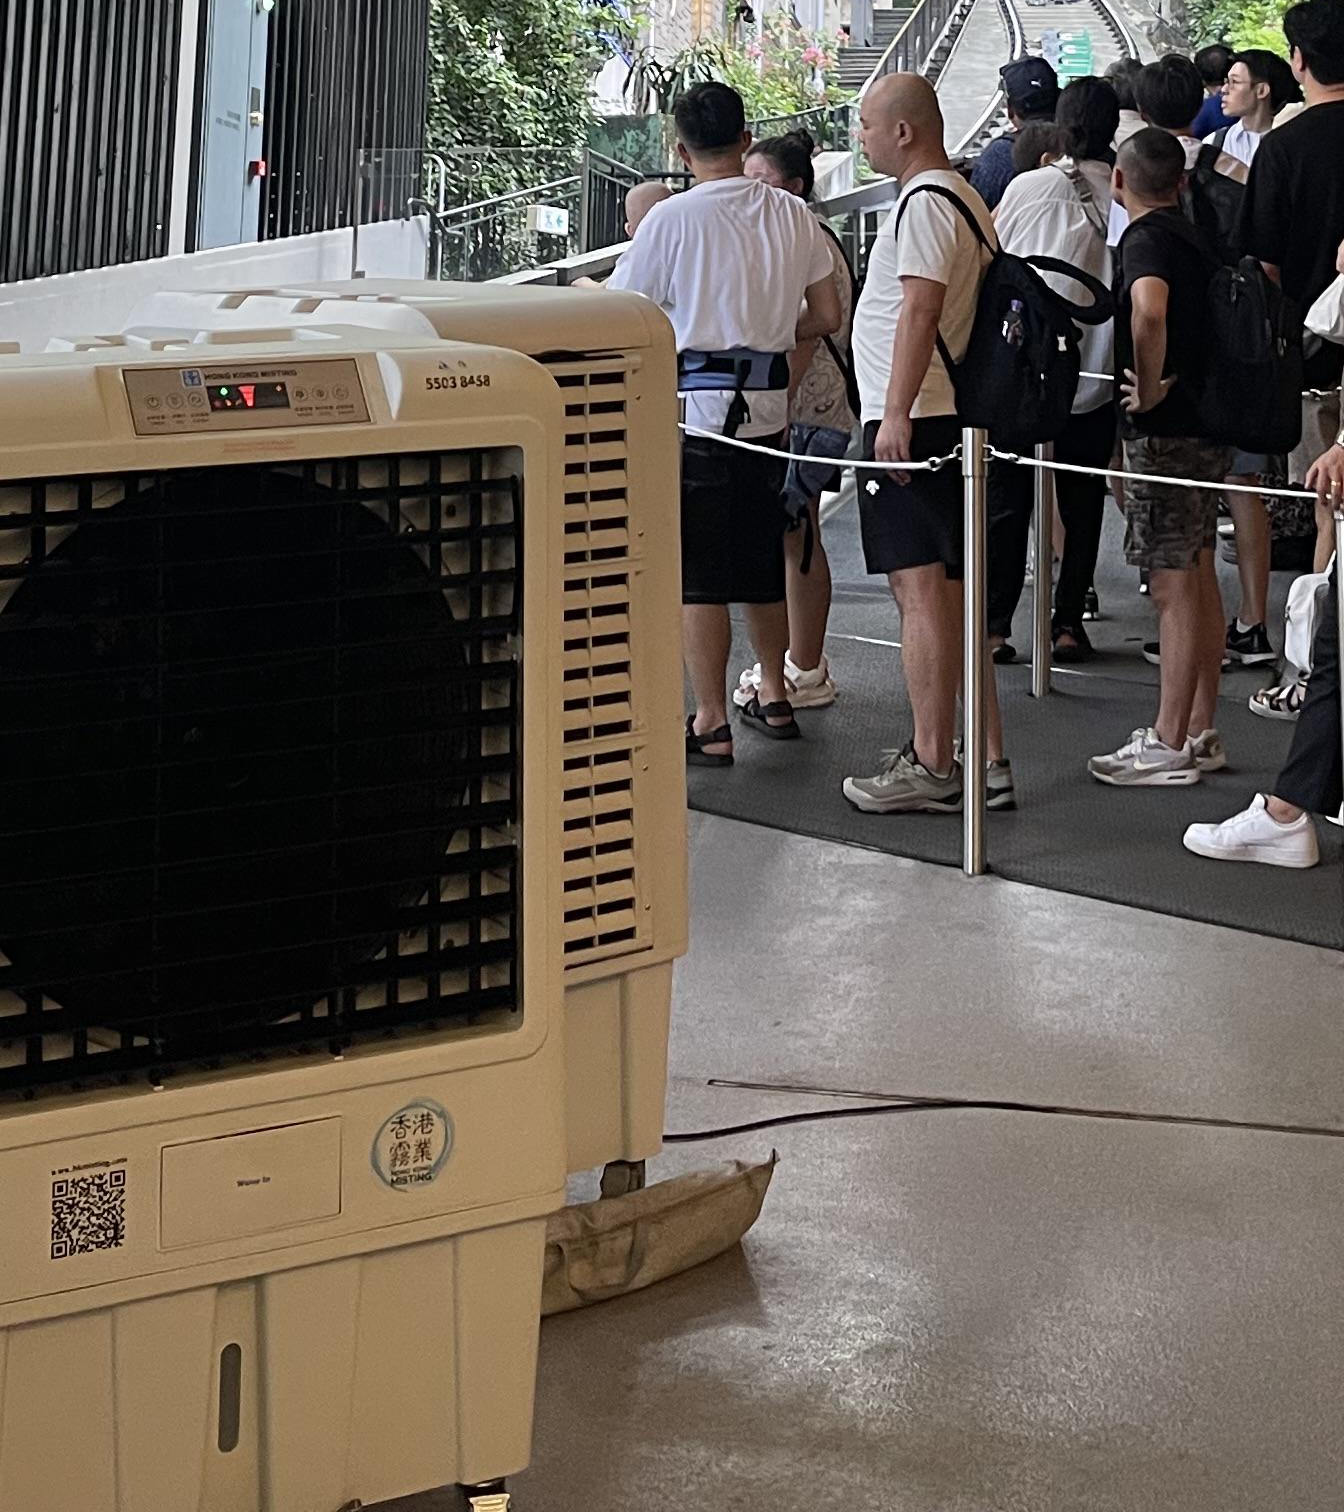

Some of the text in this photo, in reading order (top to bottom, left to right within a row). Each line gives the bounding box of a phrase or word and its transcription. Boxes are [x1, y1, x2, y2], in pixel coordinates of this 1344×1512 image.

[425, 374, 491, 390] 5503 8458
[389, 1111, 435, 1140] 香港
[390, 1172, 433, 1185] MISTING
